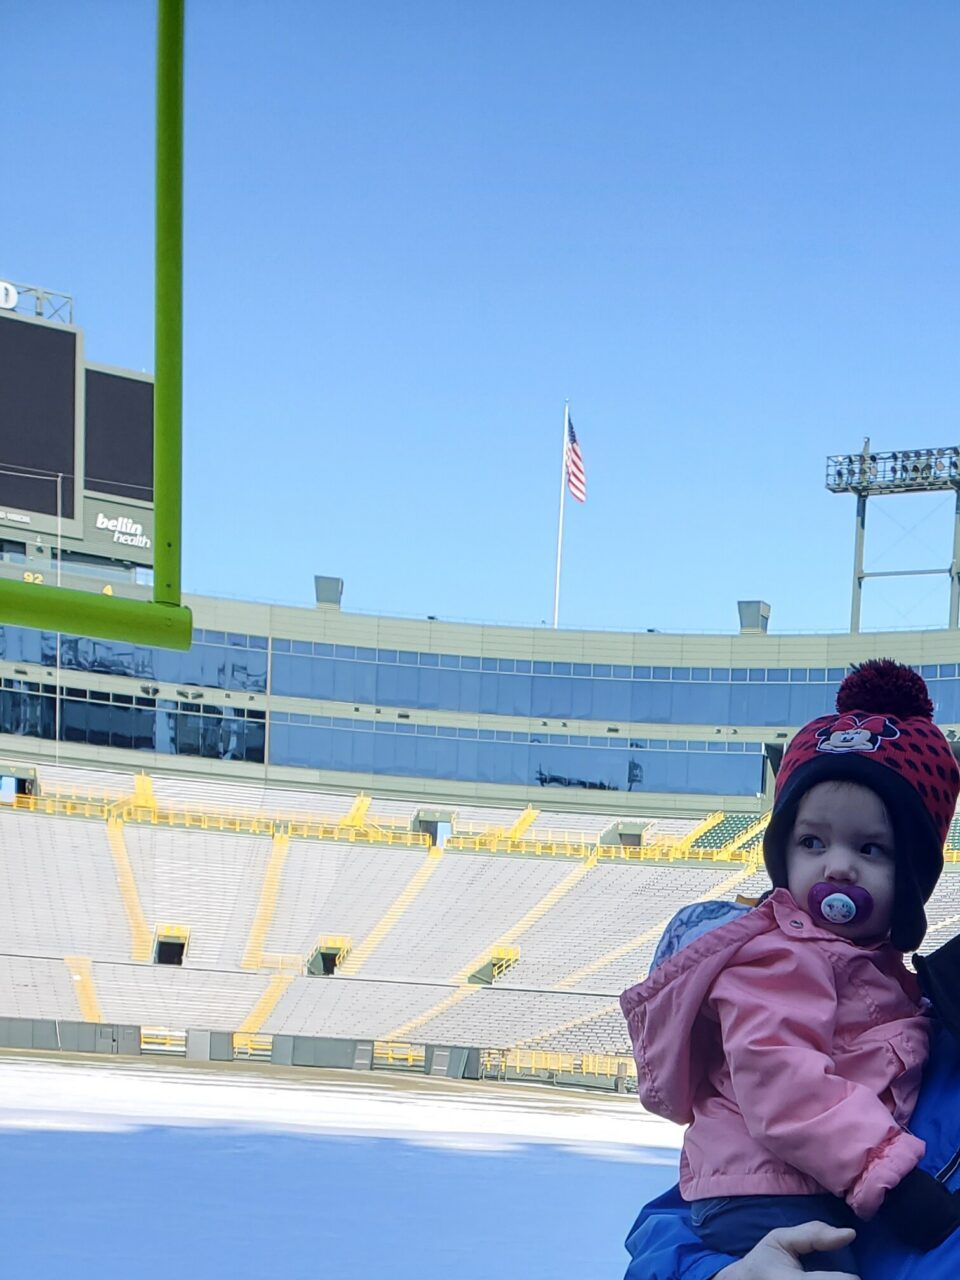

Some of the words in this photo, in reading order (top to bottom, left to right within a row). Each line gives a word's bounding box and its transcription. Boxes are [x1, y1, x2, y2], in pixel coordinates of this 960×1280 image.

[96, 513, 143, 535] bellin
[113, 531, 152, 548] health
[23, 571, 44, 585] 92
[102, 585, 113, 597] 4
